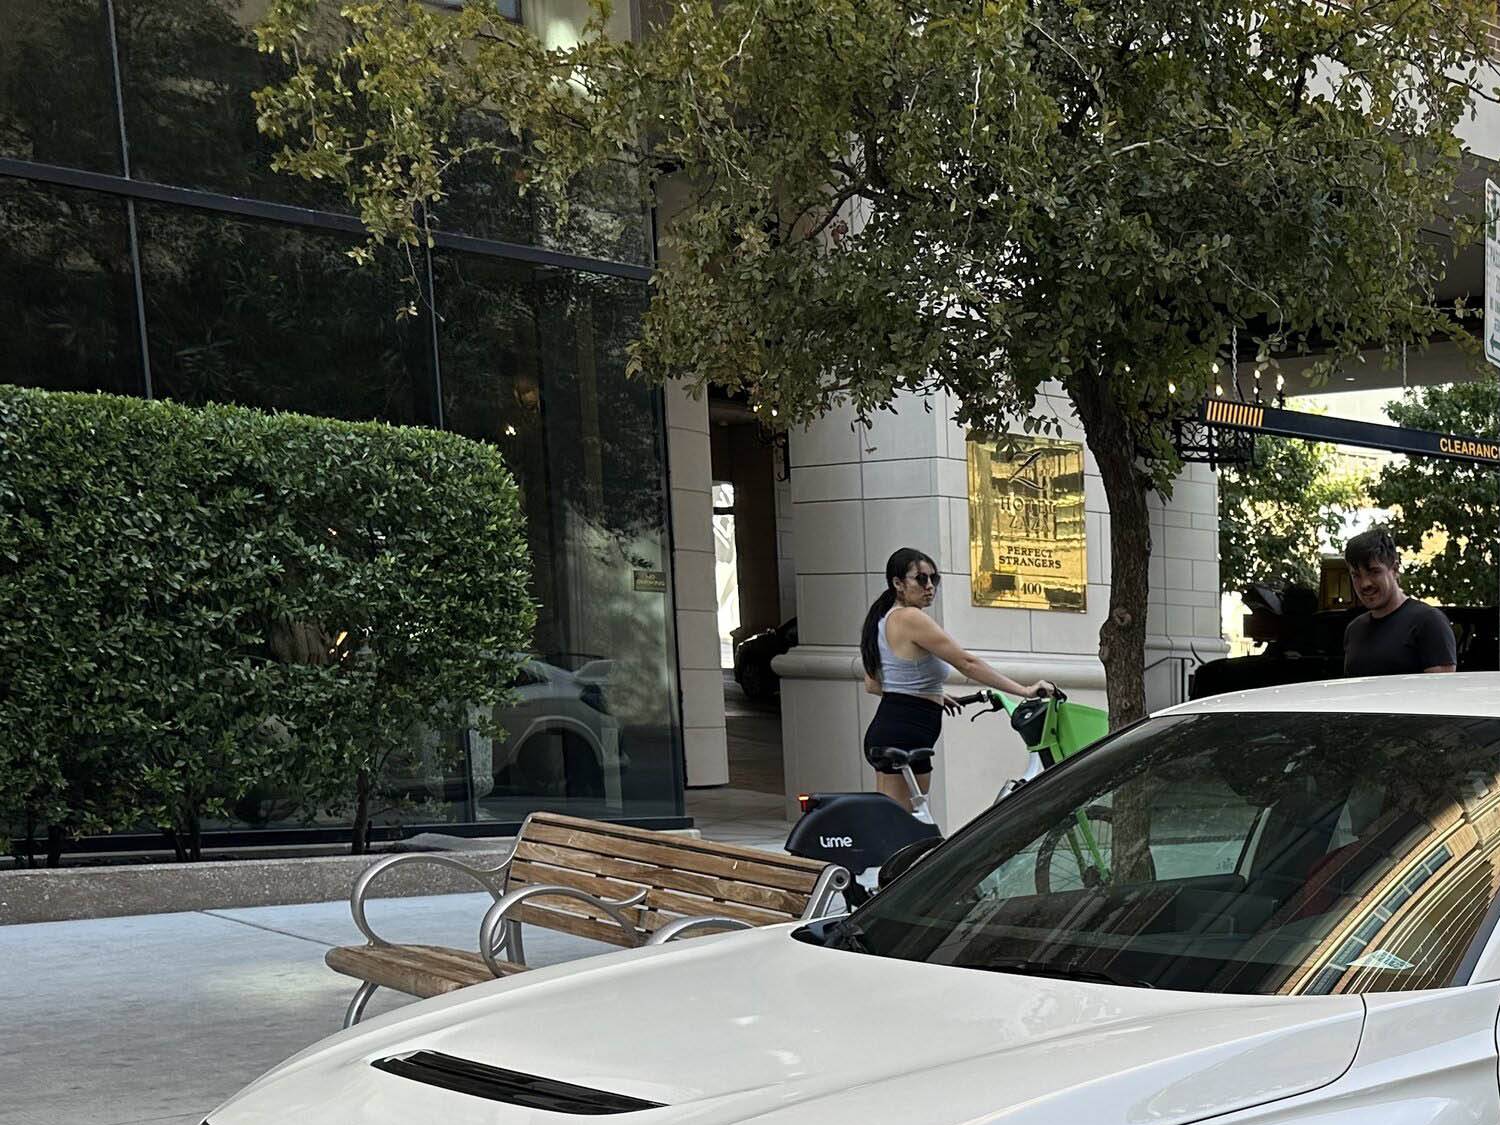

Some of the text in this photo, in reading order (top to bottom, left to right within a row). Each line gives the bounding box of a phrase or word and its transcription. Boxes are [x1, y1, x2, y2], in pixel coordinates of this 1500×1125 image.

[1000, 496, 1057, 514] HOTEL
[1007, 546, 1053, 558] PERFECT
[999, 555, 1062, 569] STRANGERS
